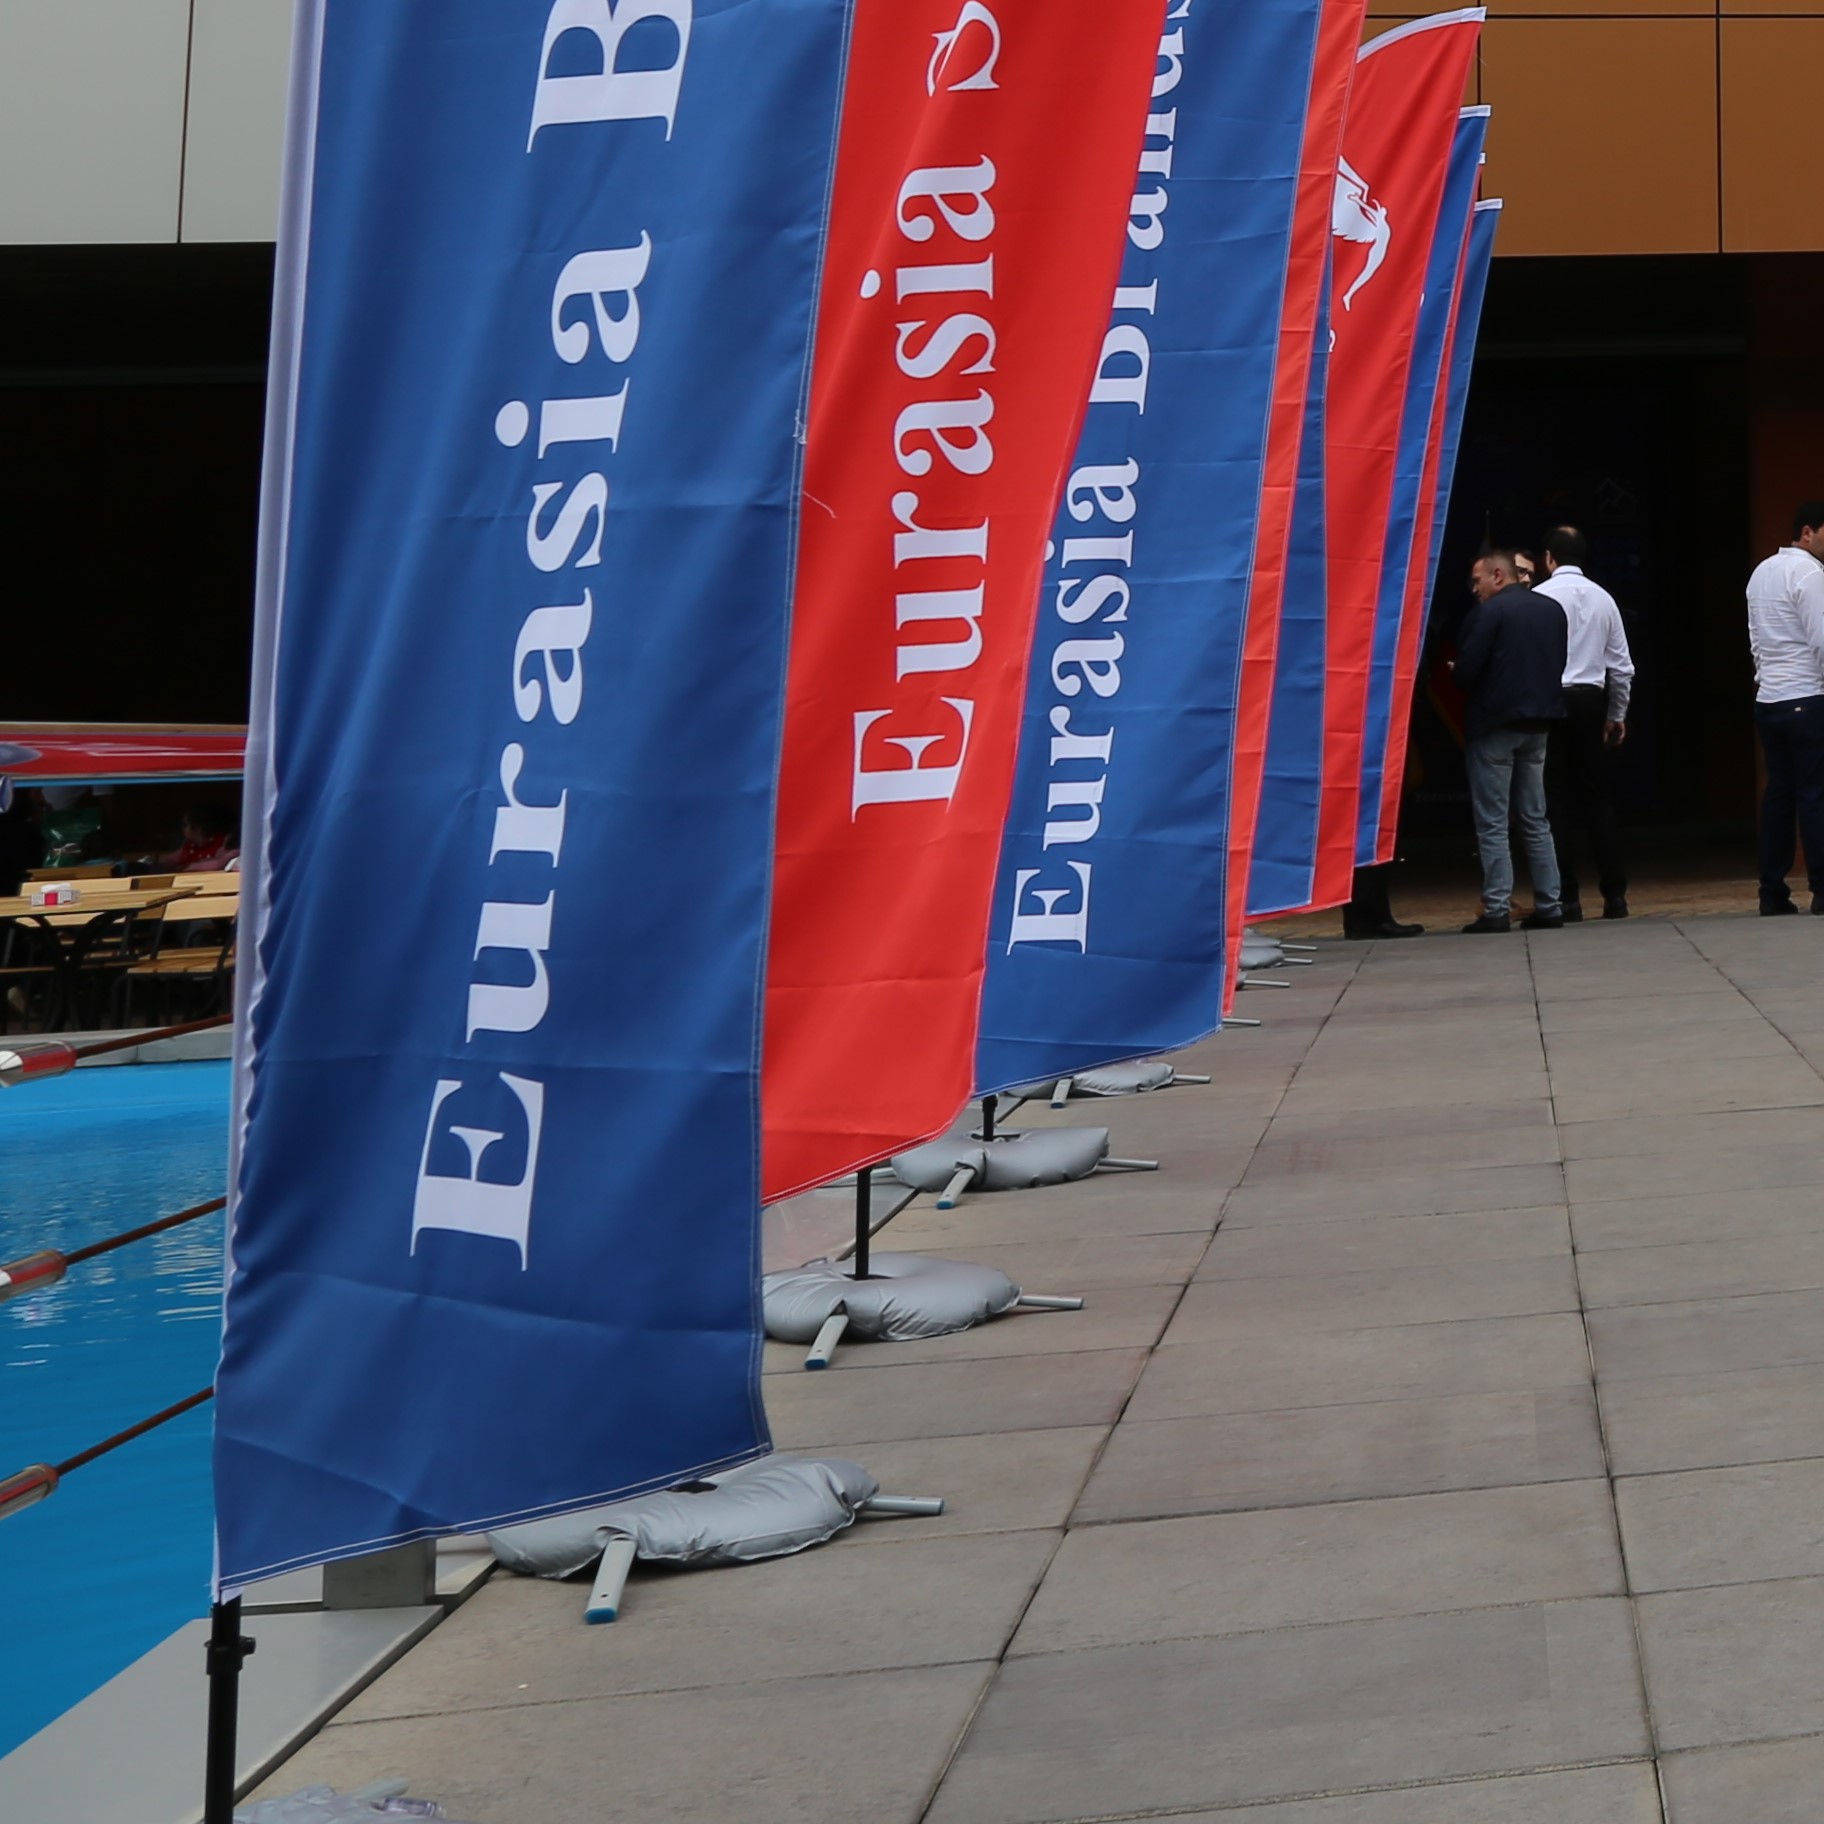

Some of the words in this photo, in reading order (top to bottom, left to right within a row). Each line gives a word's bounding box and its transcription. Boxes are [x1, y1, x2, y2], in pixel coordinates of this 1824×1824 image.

[411, 230, 651, 1270] Eurasia
[853, 156, 995, 817] Eurasia
[1007, 457, 1138, 955] Eurasia
